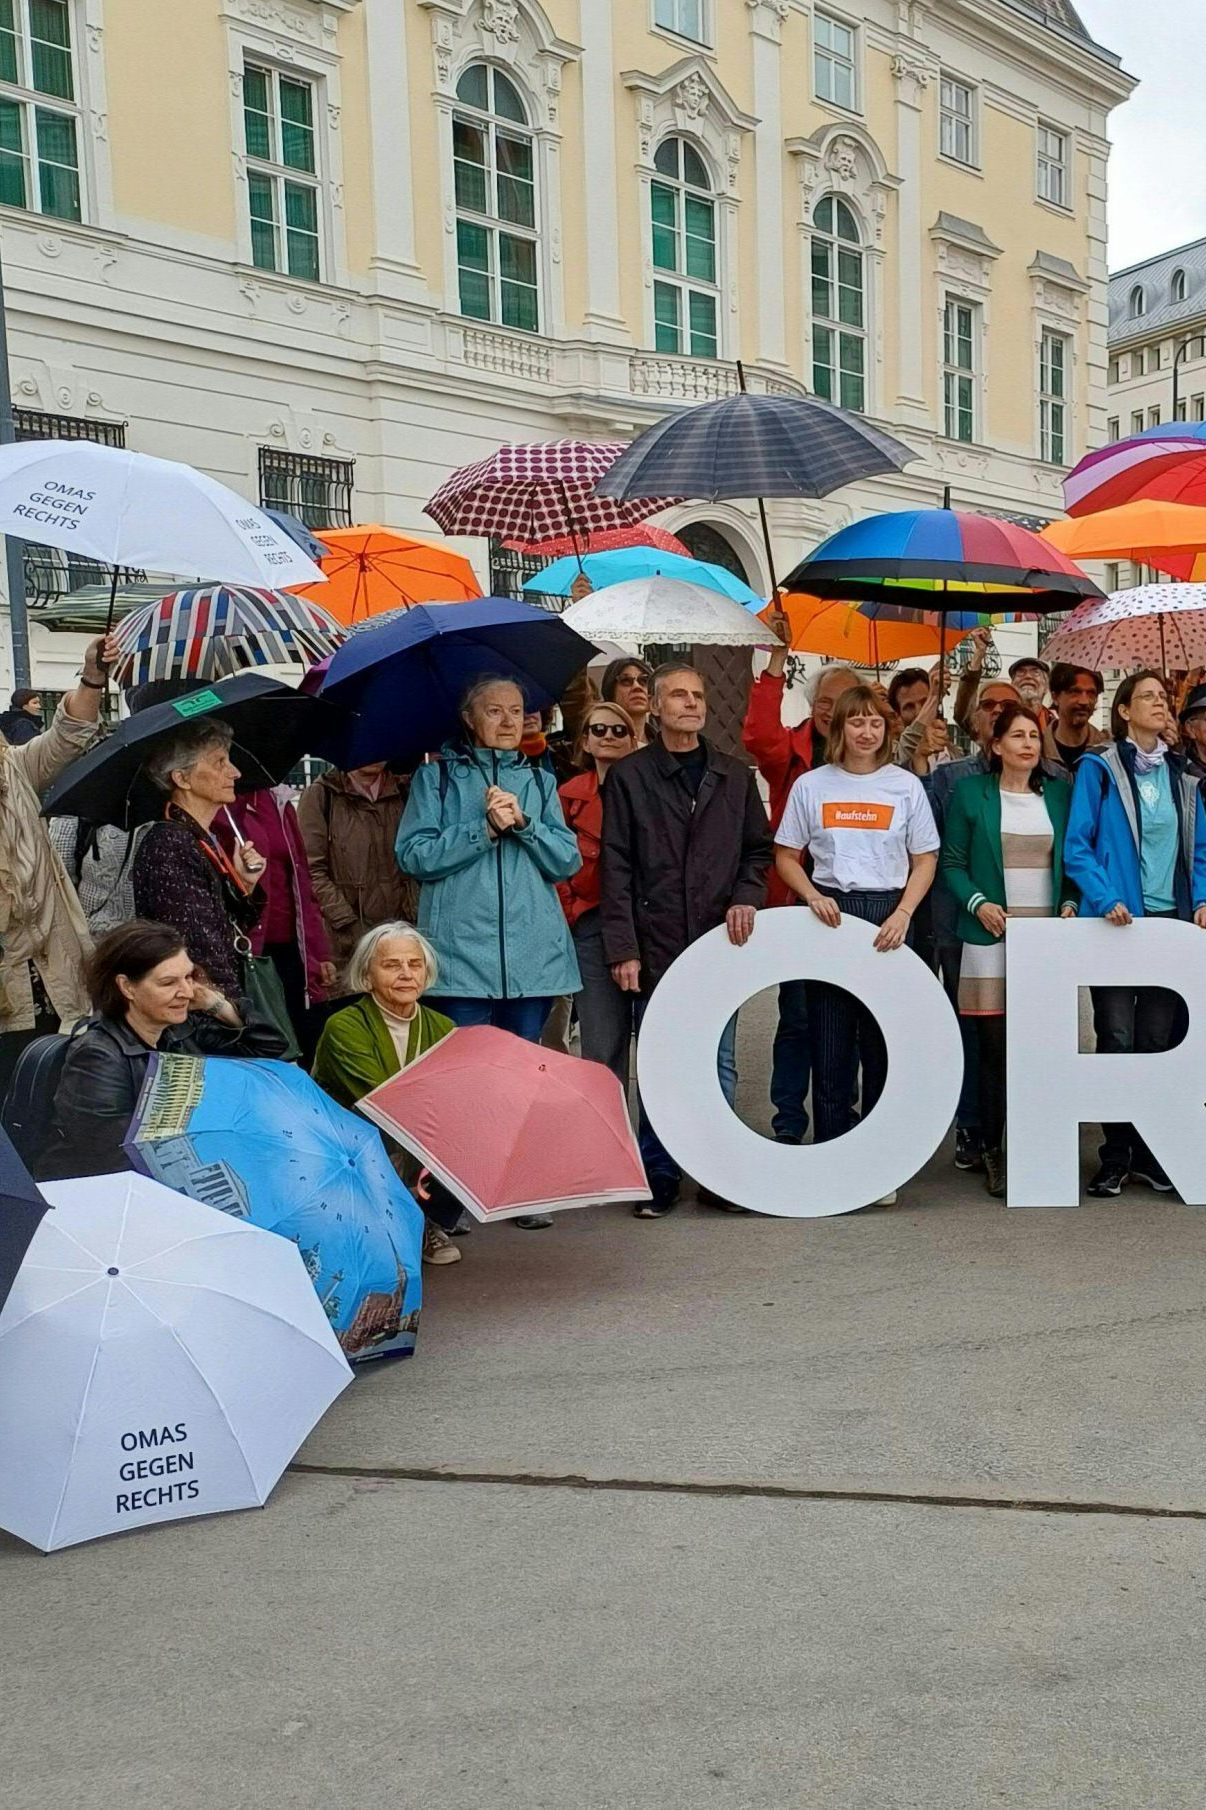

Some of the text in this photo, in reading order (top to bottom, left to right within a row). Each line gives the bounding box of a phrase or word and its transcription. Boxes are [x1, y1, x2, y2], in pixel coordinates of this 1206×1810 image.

[29, 492, 89, 515] GEGEN
[43, 481, 97, 501] OMAS
[12, 504, 81, 530] RECHTS
[120, 1422, 188, 1452] OMAS
[119, 1451, 195, 1482] GEGEN
[115, 1479, 200, 1514] RECHTS
